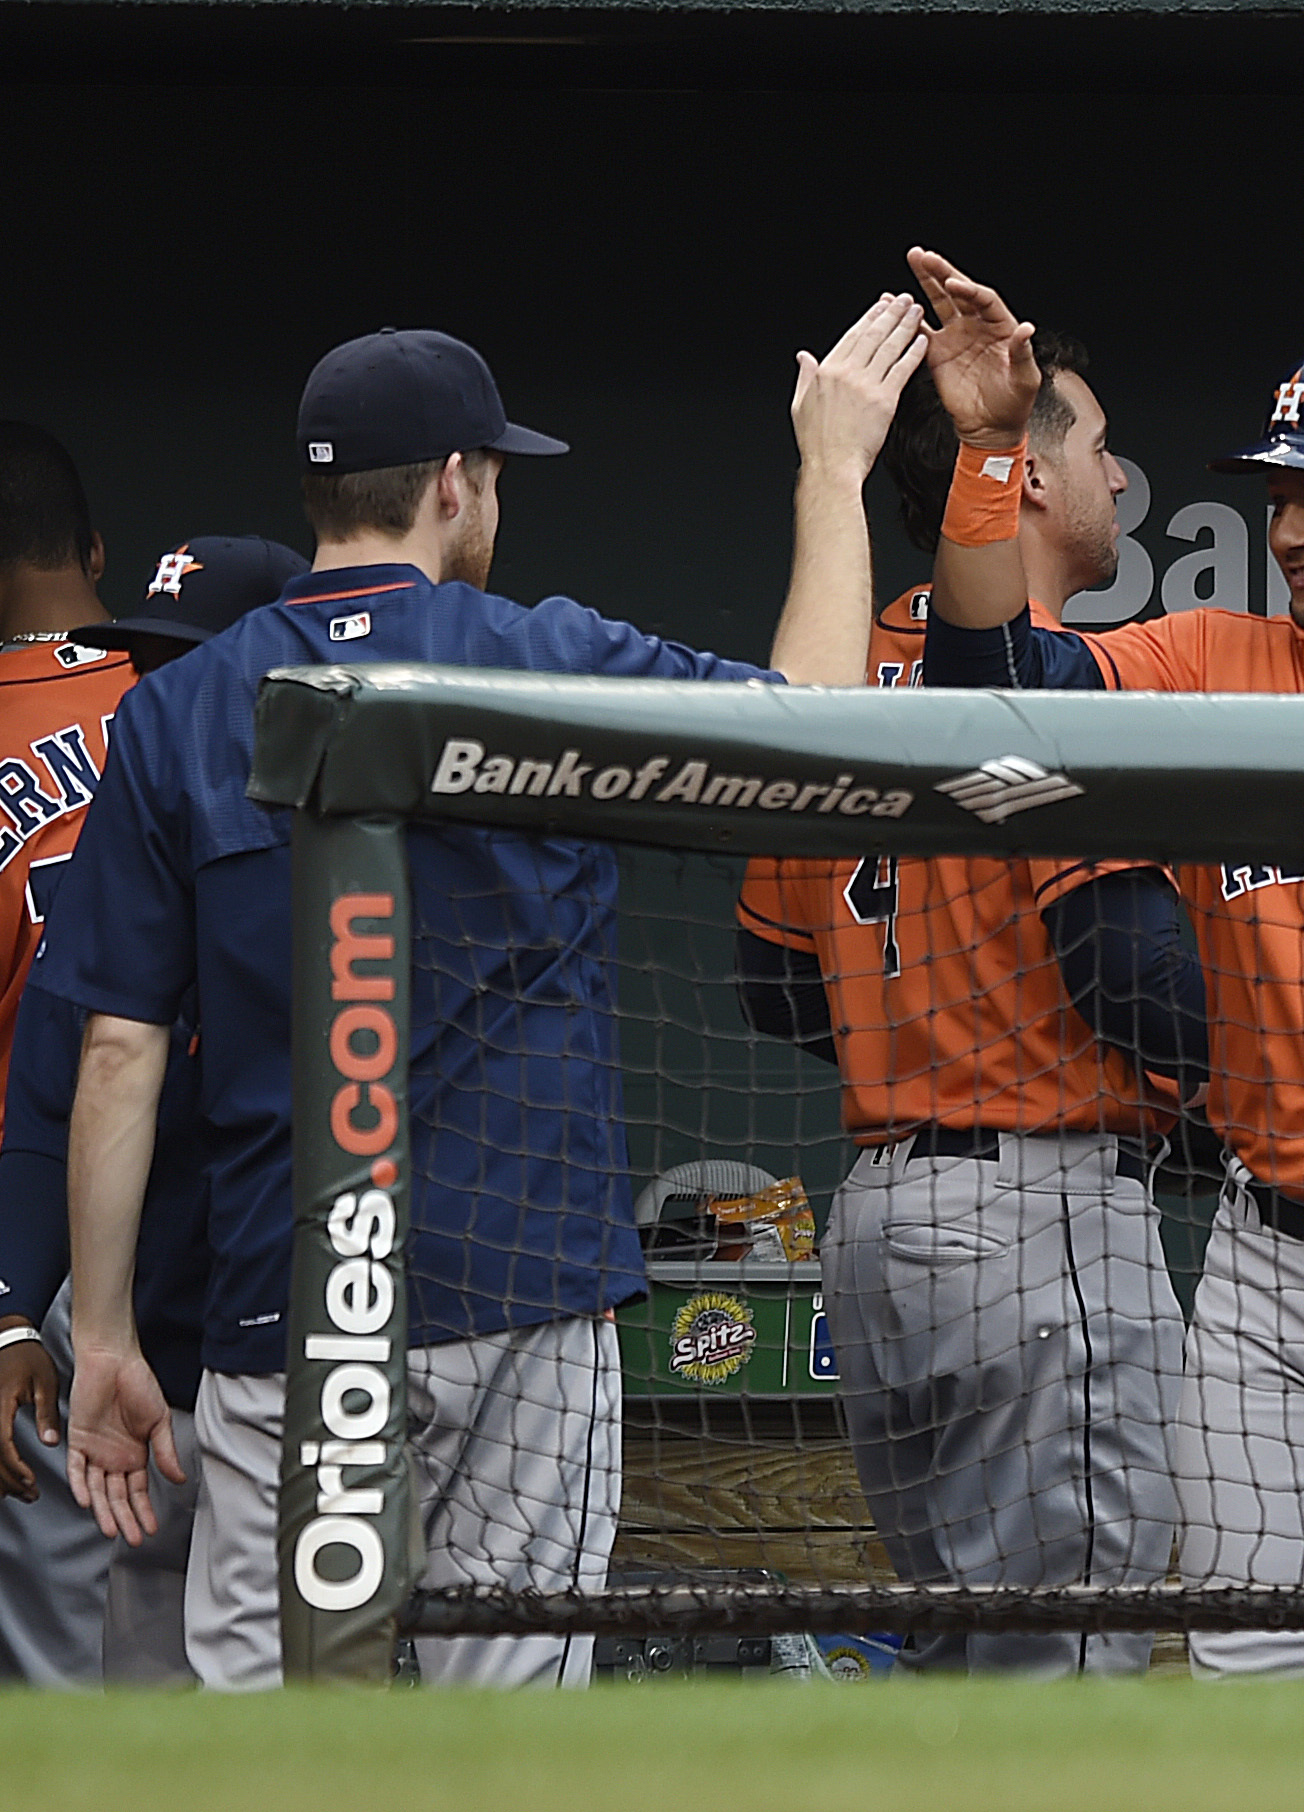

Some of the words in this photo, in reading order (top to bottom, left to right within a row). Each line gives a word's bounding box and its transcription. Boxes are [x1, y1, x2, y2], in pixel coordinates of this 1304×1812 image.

[148, 553, 194, 594] H
[431, 740, 594, 798] Bank
[590, 758, 670, 801] of
[656, 761, 914, 819] America
[842, 855, 901, 981] 4
[294, 891, 399, 1612] Orioles.com
[671, 1321, 756, 1371] Spitz
